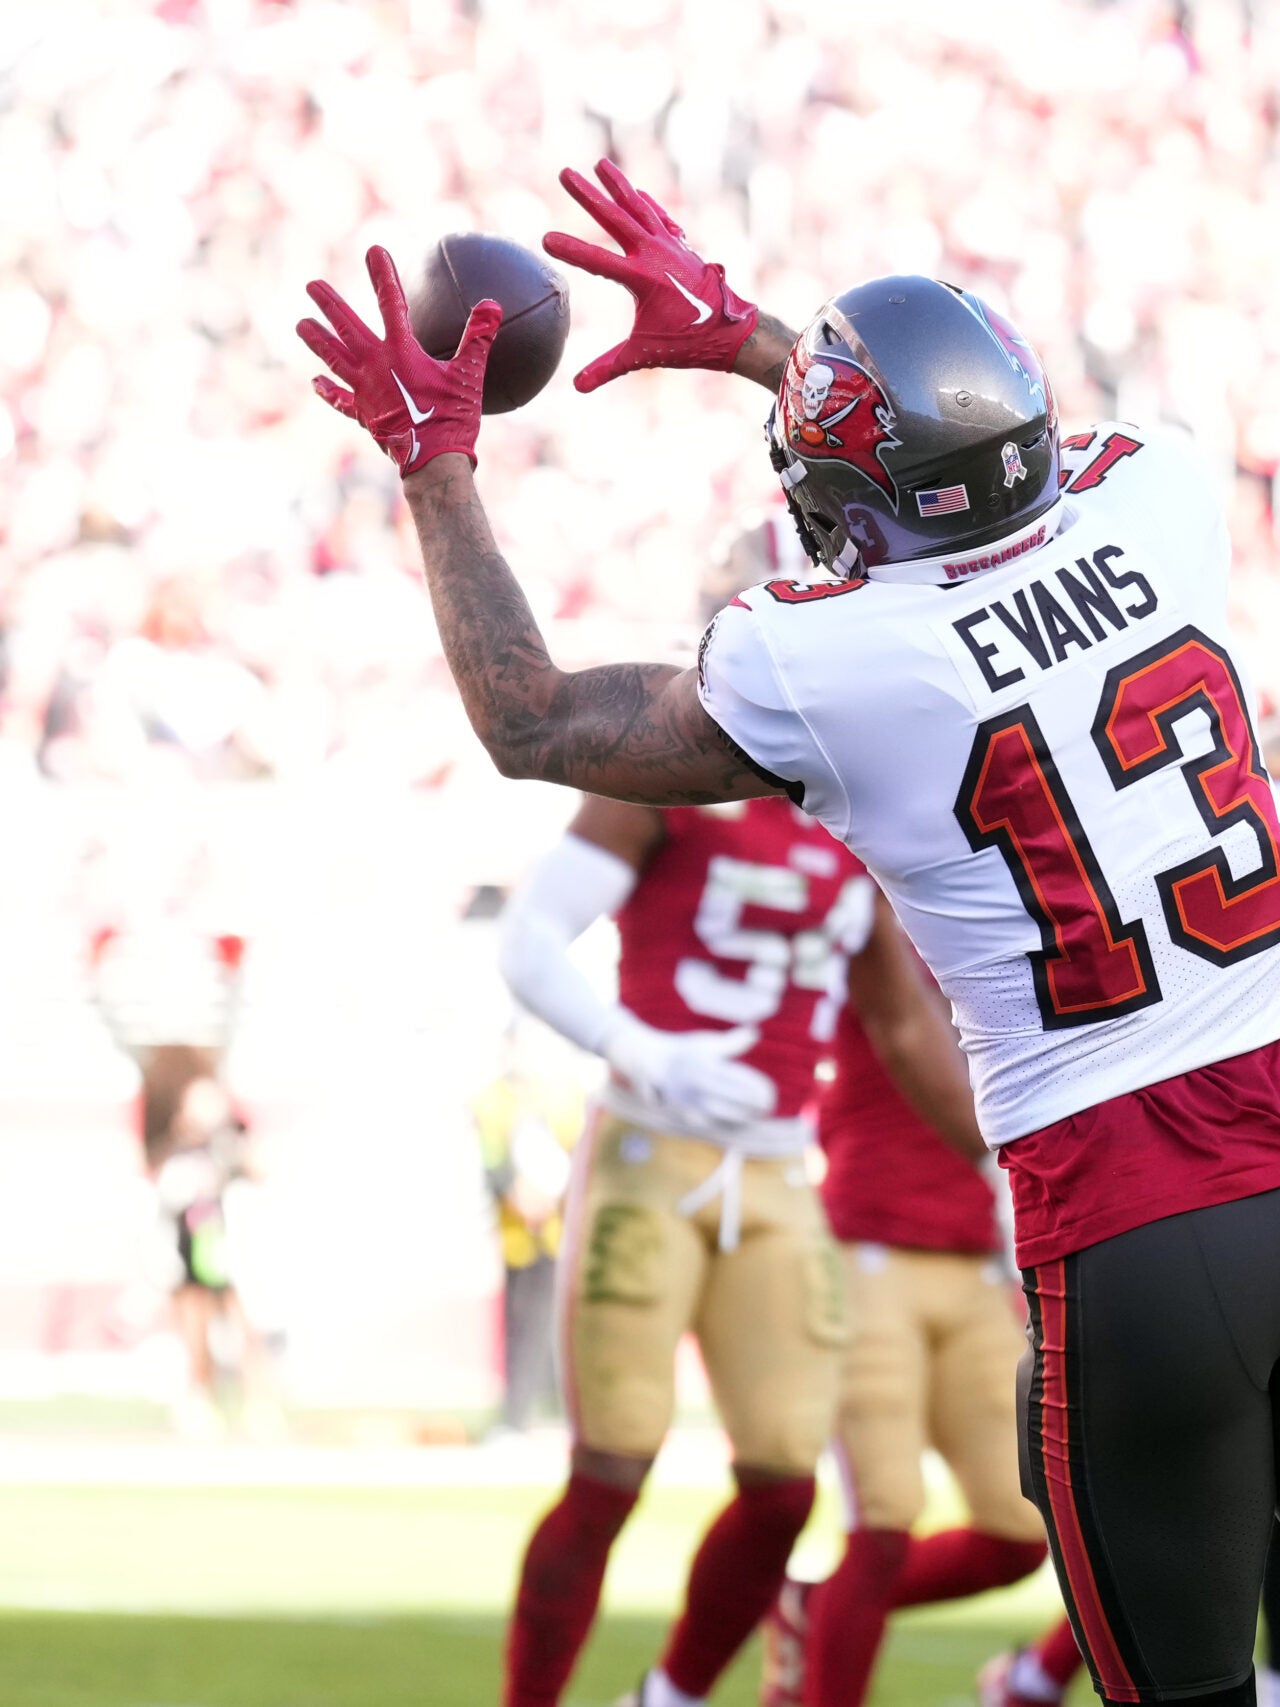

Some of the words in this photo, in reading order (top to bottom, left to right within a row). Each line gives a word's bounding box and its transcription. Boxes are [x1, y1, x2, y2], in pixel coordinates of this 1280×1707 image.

[942, 525, 1046, 580] BUCCANEERS
[952, 544, 1158, 693] EVANS
[674, 855, 875, 1042] 54
